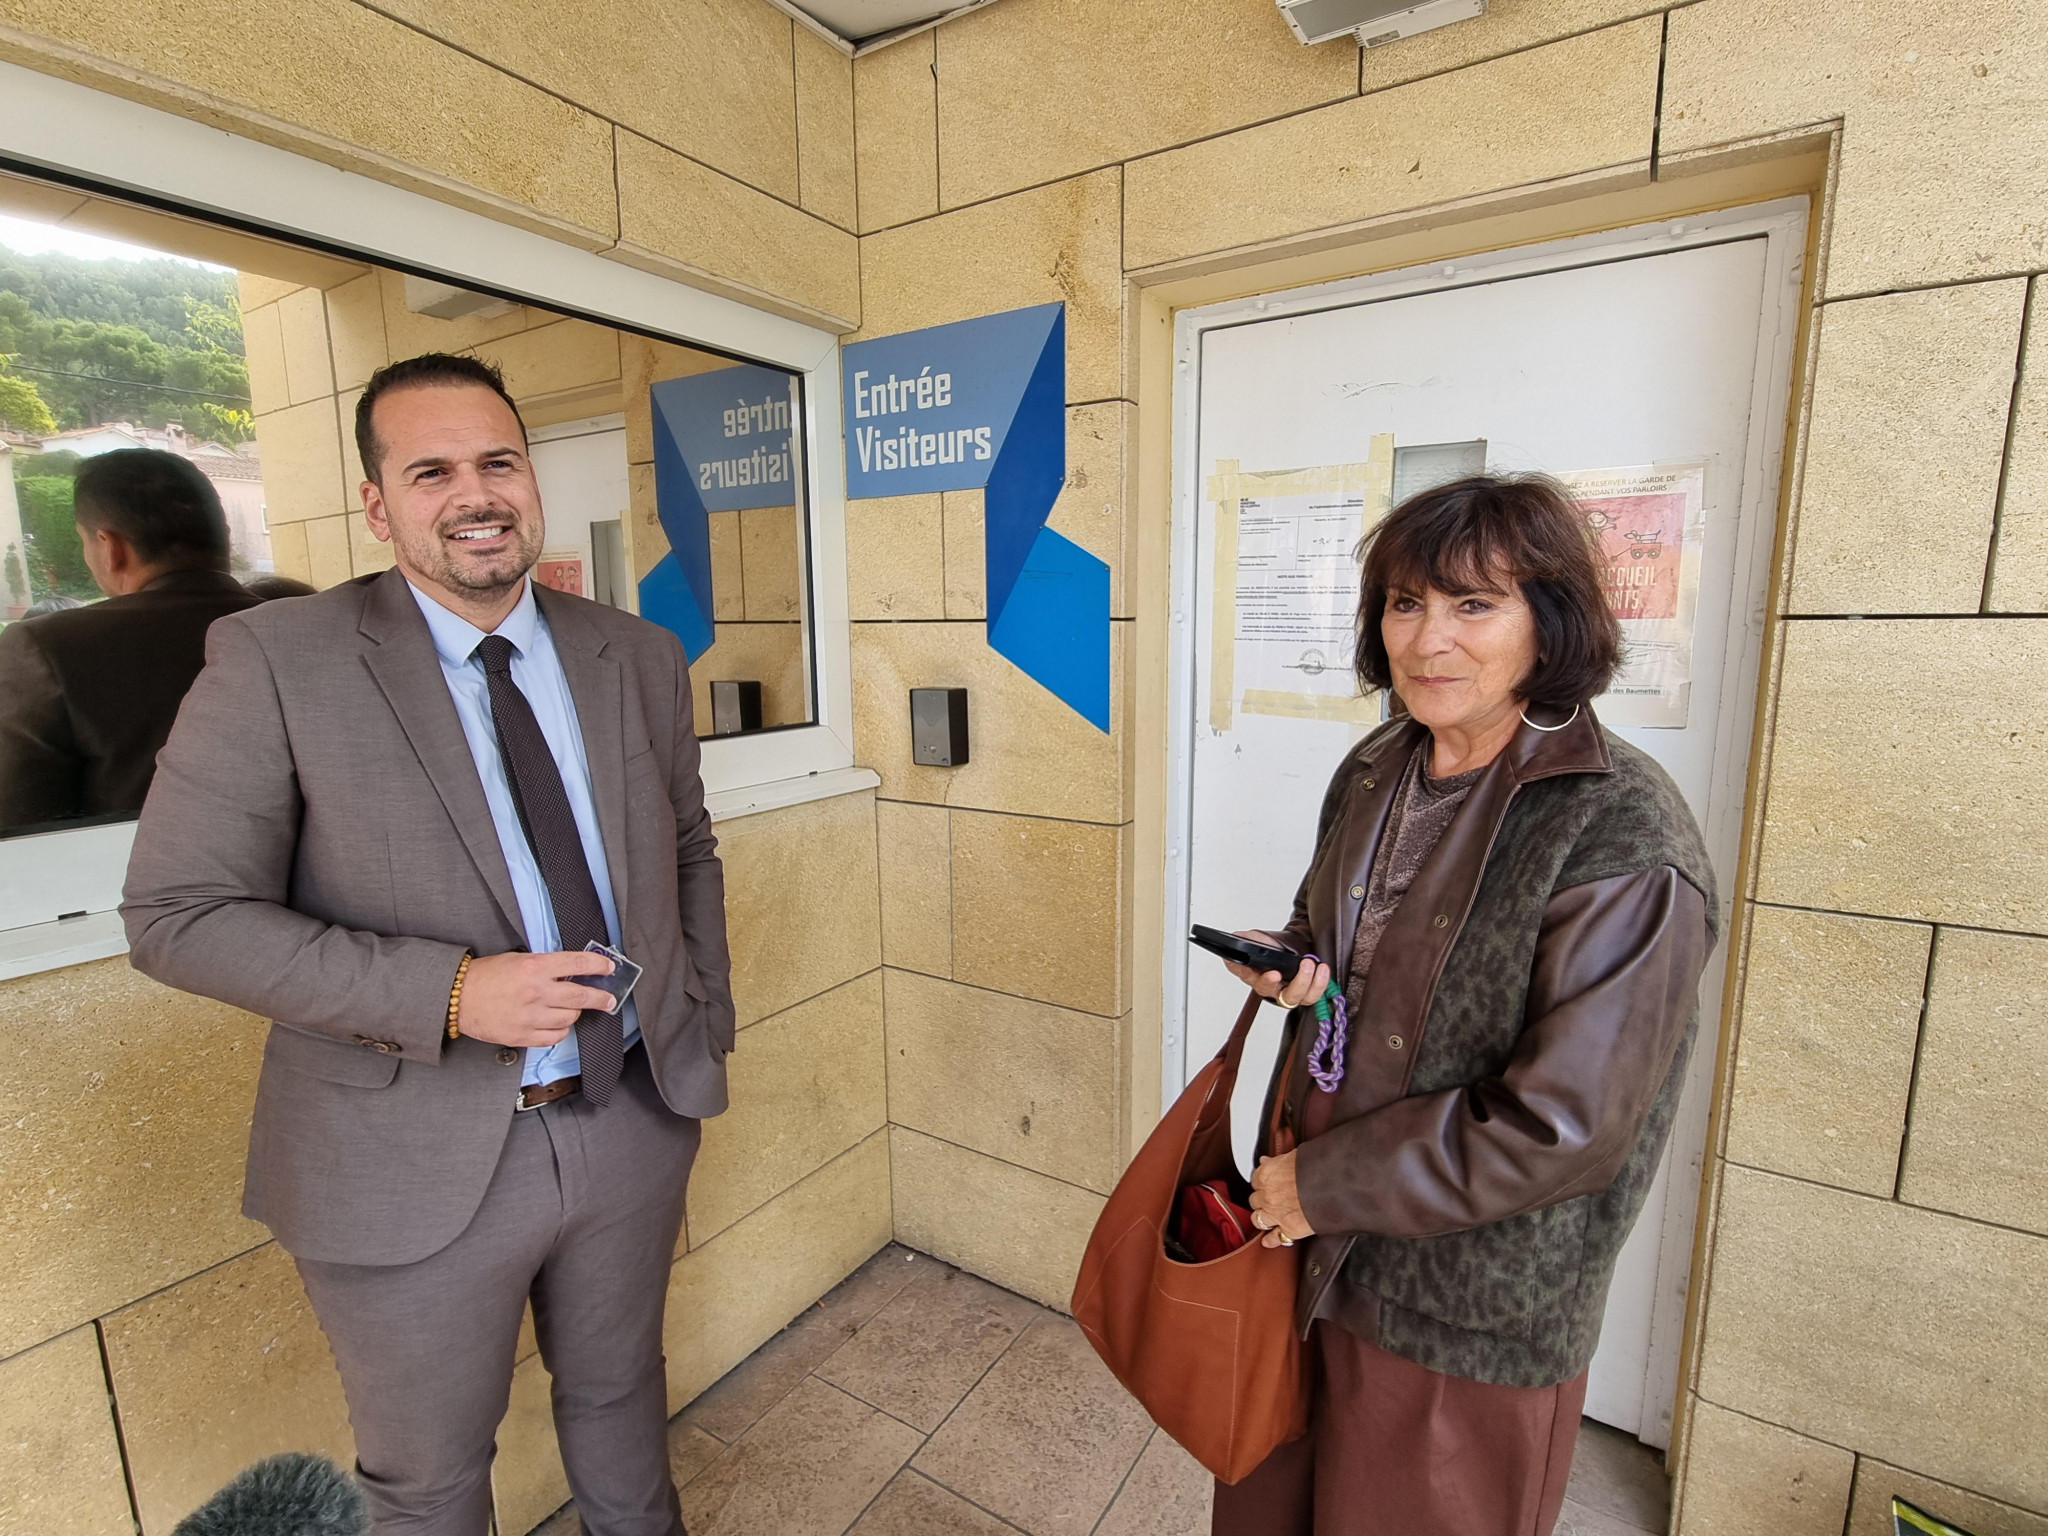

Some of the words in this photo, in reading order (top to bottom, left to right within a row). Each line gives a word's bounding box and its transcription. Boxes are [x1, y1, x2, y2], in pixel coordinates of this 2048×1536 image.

[854, 366, 951, 418] Entrée
[855, 426, 991, 473] Visiteurs
[1628, 477, 1637, 485] LA
[1639, 475, 1665, 484] GARDE
[1666, 474, 1677, 482] DE
[1616, 487, 1631, 495] VOS
[1632, 484, 1668, 493] PARLOIRS
[1626, 687, 1661, 695] Baumettes
